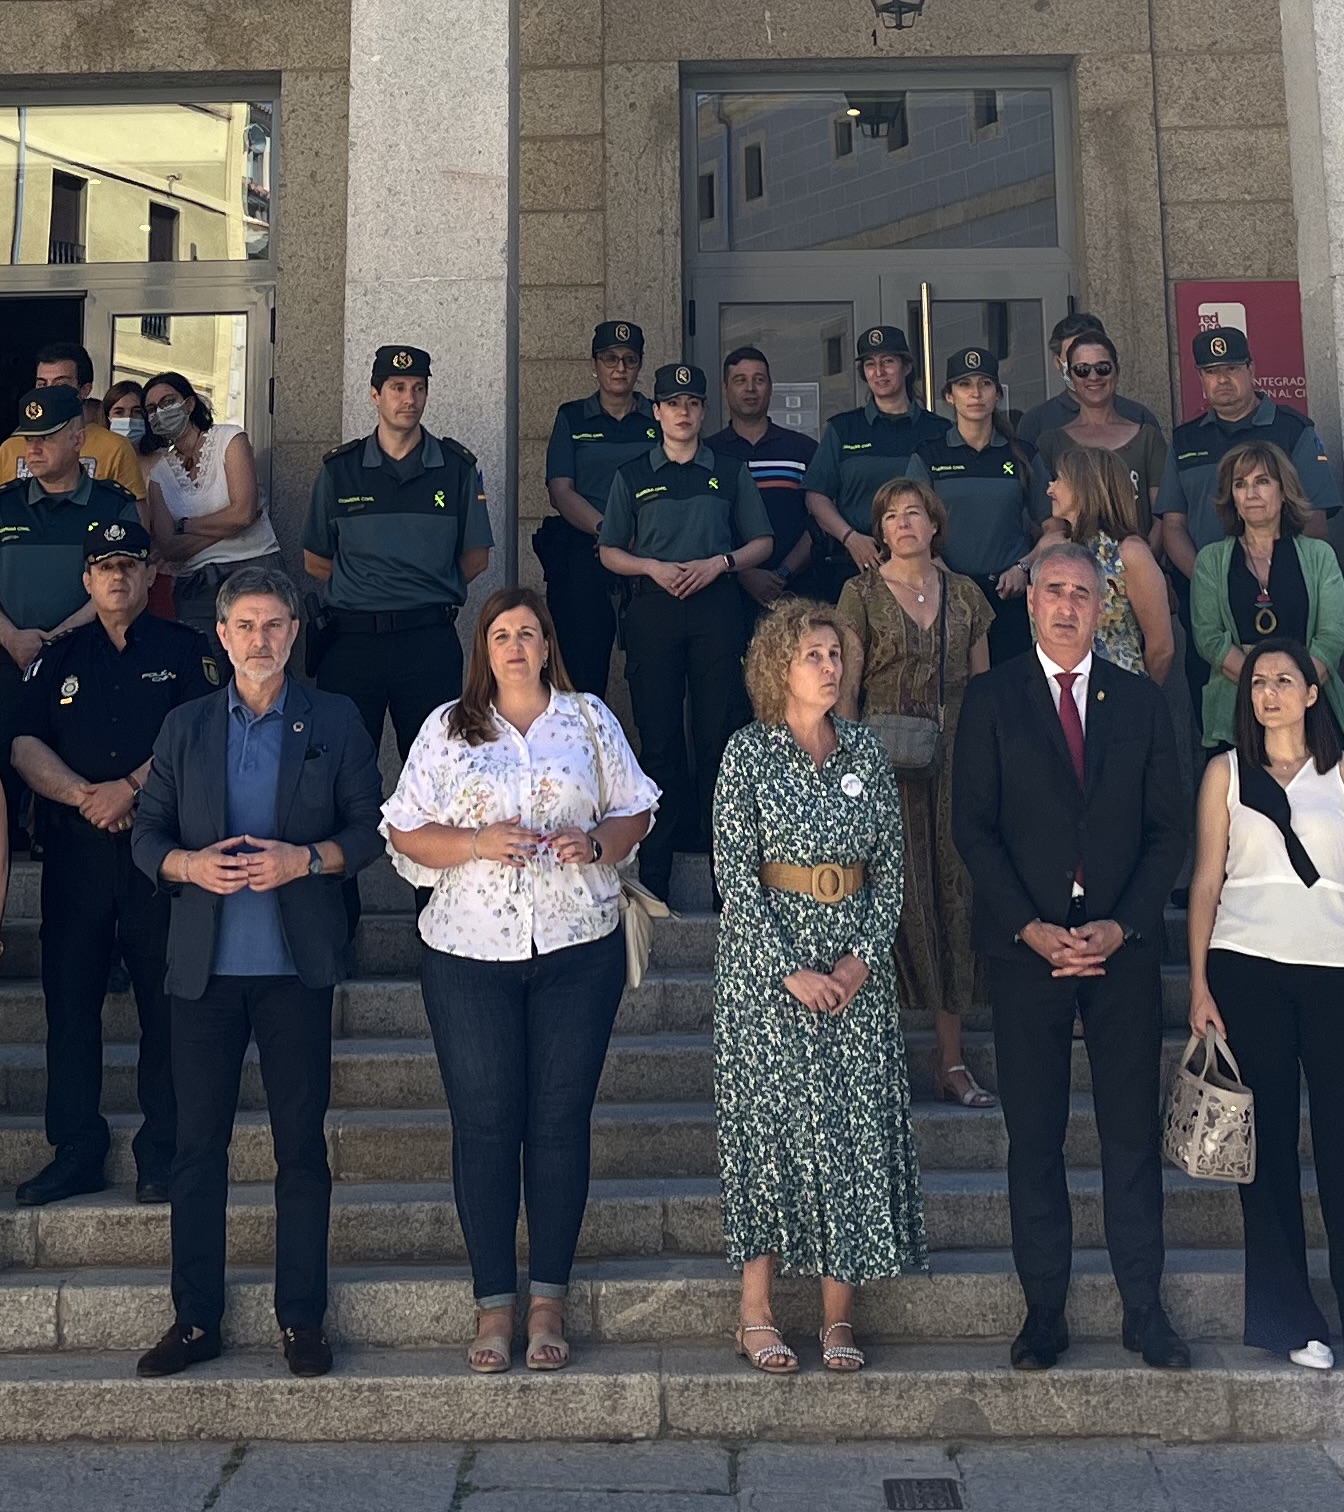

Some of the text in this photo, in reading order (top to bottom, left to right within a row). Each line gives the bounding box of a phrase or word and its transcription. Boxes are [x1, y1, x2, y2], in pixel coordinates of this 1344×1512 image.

[1199, 311, 1219, 324] red
[1252, 377, 1306, 387] NTEGRAD
[1279, 389, 1292, 398] AL
